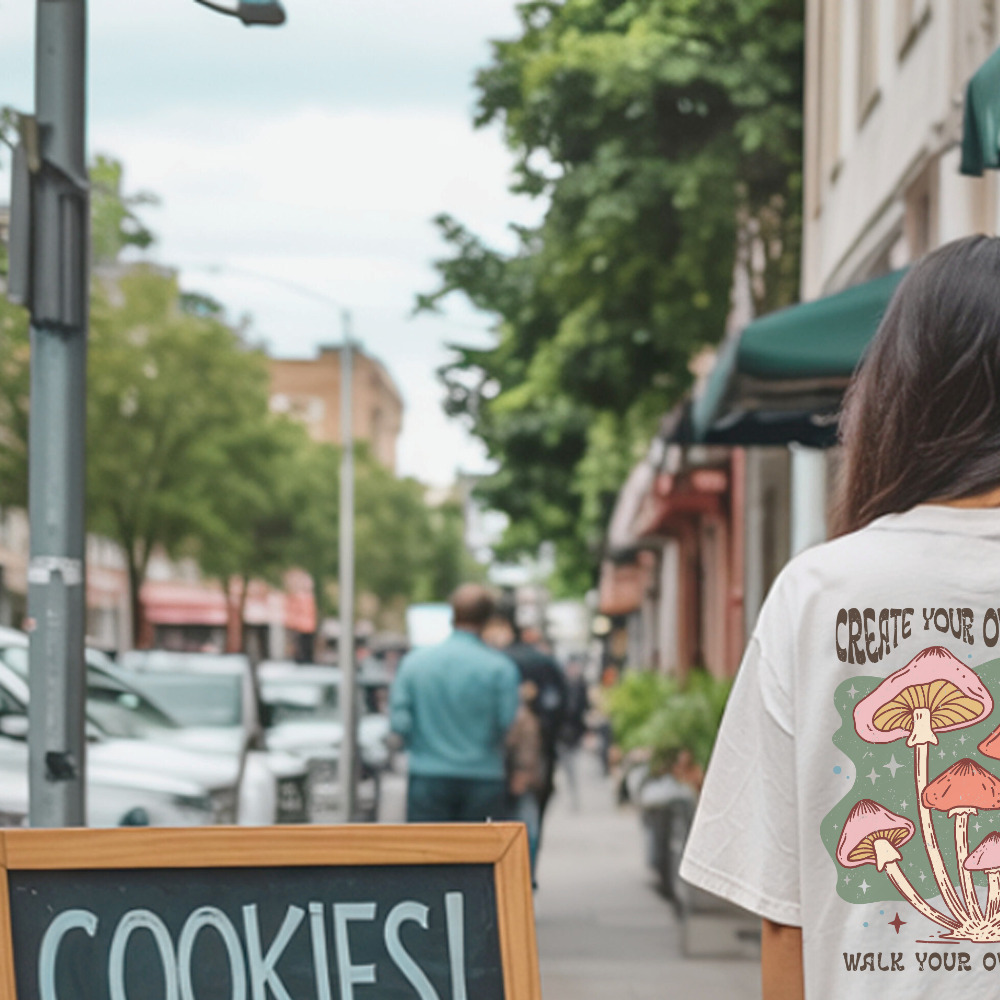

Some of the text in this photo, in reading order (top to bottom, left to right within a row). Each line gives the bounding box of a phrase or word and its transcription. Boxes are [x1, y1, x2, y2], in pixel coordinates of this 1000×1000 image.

[835, 607, 914, 665] CREATE
[922, 607, 975, 646] YOUR
[842, 951, 905, 972] WALK
[914, 951, 972, 972] YOUR
